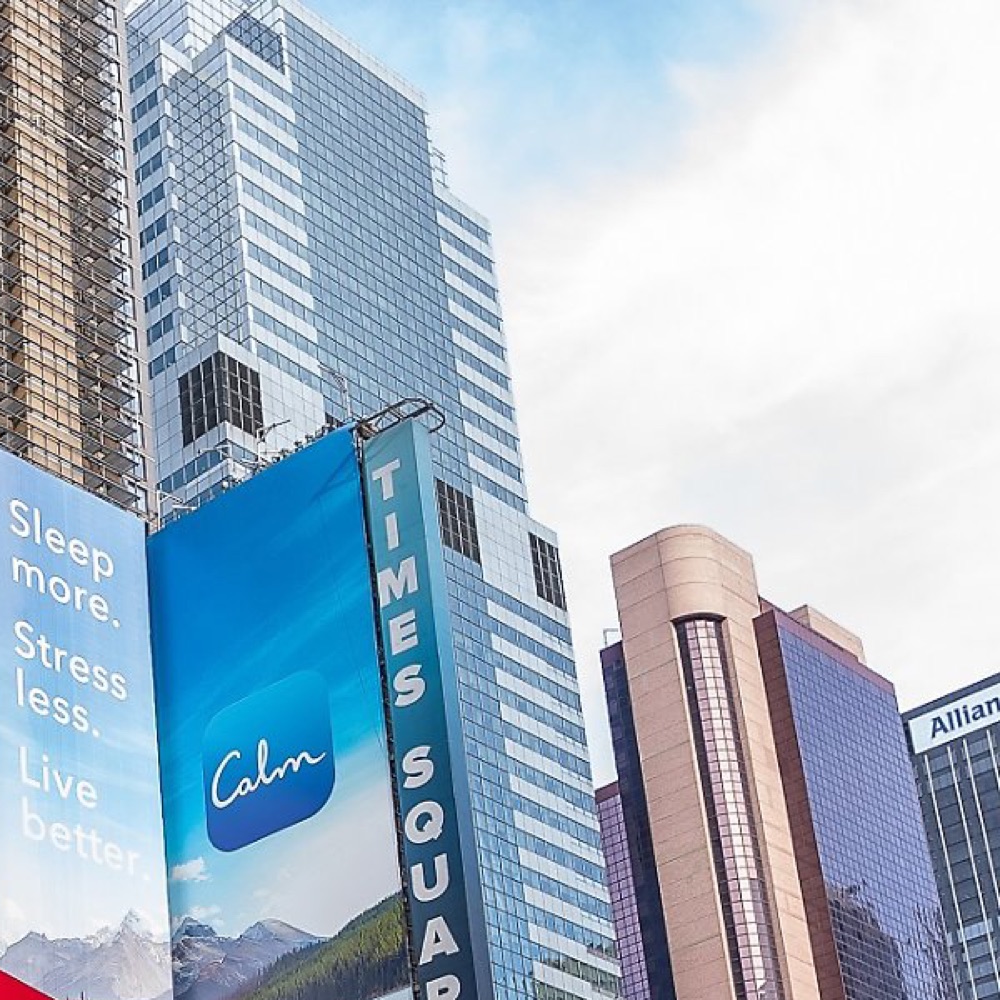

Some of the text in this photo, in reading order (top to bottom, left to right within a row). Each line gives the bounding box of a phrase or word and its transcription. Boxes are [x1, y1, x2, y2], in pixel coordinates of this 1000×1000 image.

[8, 498, 114, 582] Sleep
[11, 556, 121, 629] more.
[372, 459, 426, 708] TIMES
[13, 619, 129, 702] Stress
[15, 665, 100, 738] less.
[18, 745, 99, 810] Live
[211, 738, 327, 808] Calm
[21, 797, 151, 881] better.
